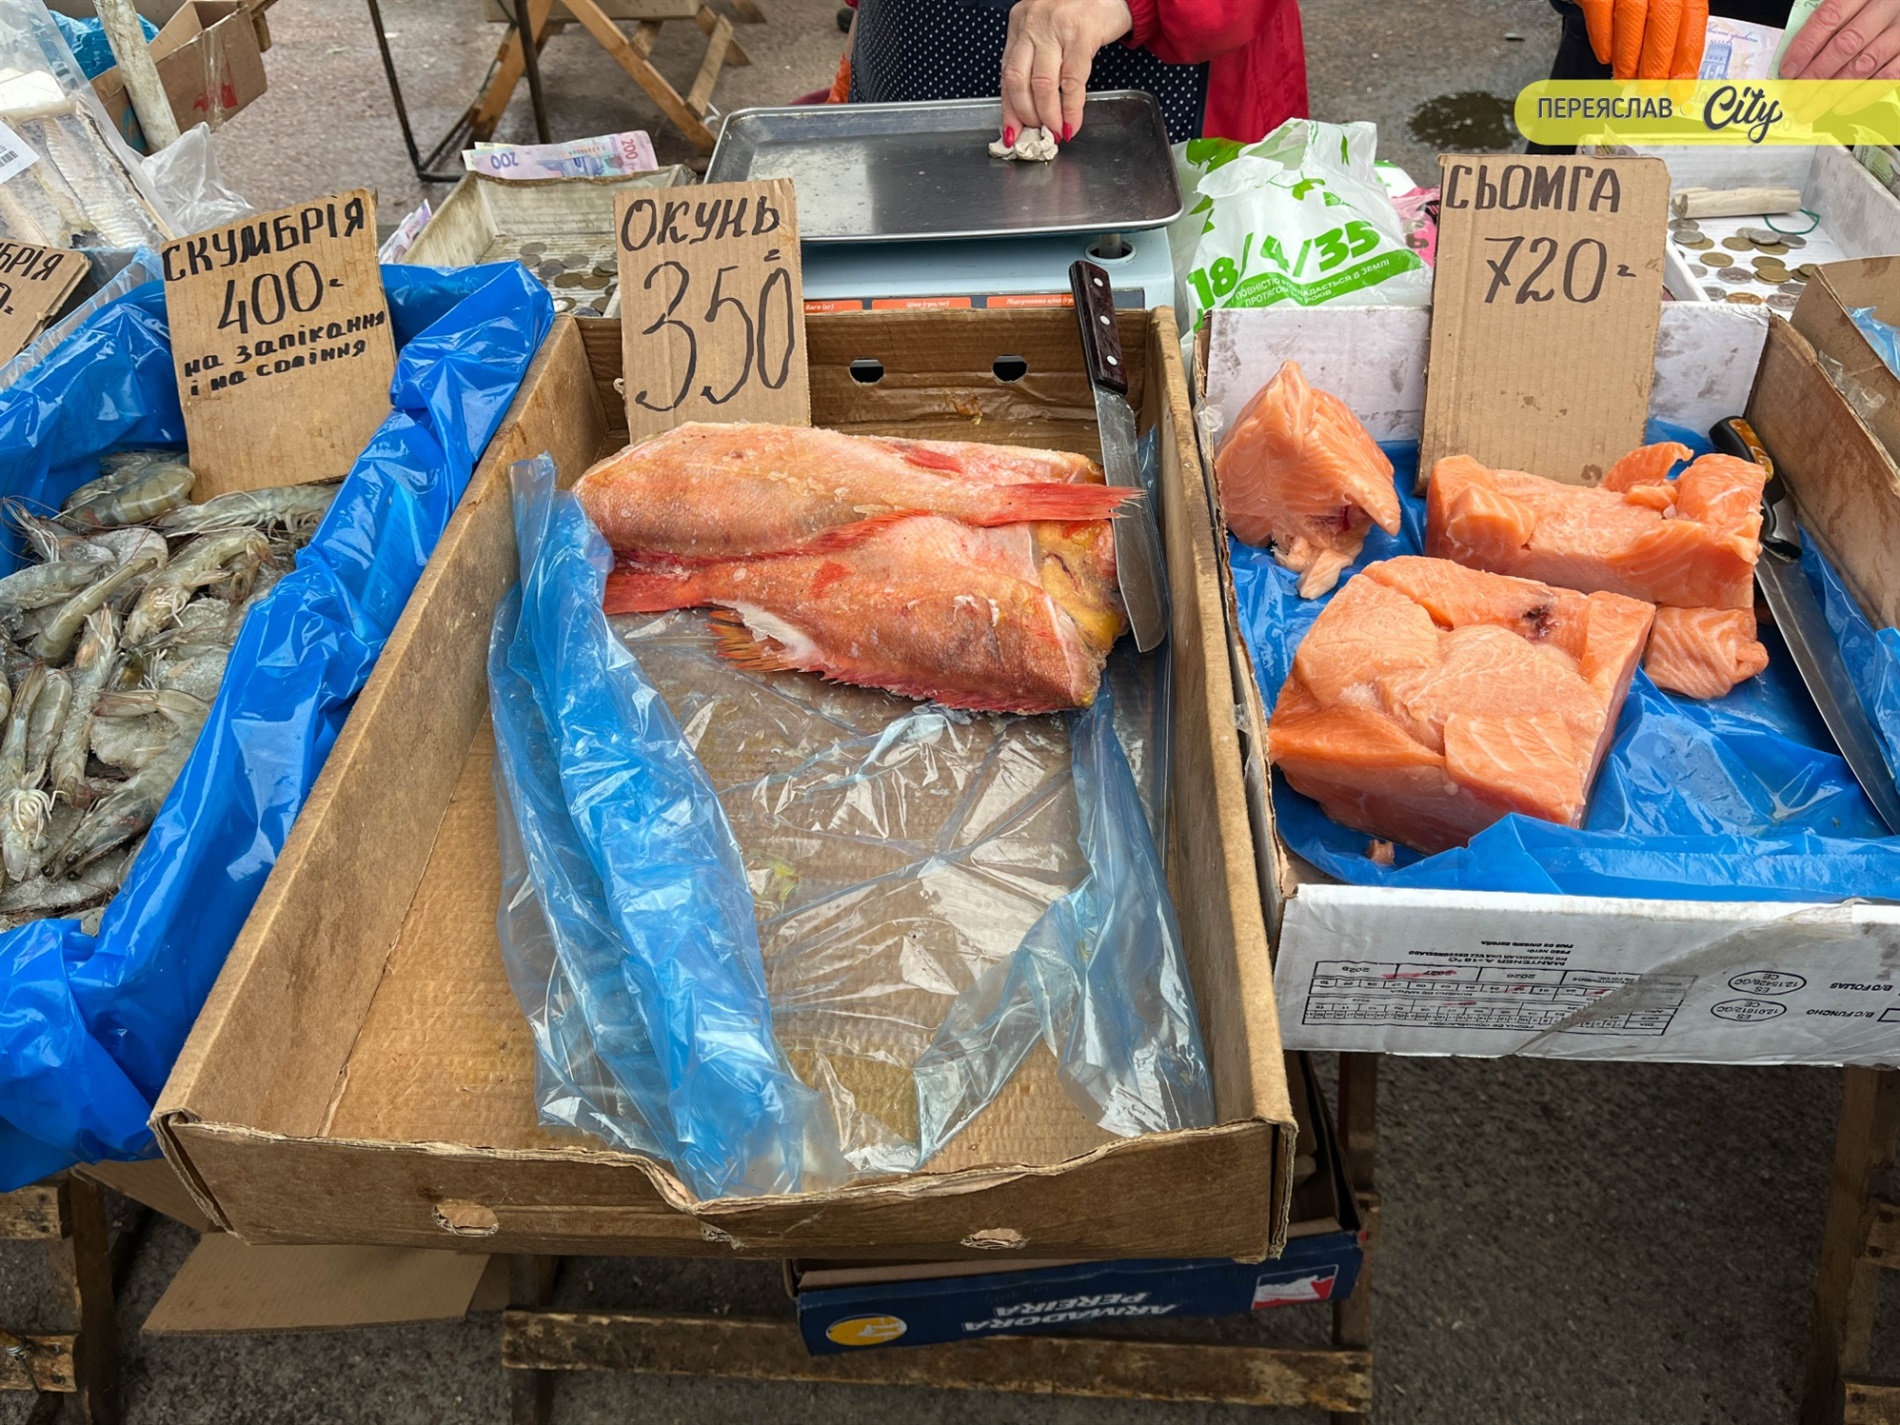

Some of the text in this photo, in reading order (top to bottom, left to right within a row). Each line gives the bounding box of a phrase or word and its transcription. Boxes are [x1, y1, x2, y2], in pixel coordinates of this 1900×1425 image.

[491, 151, 519, 169] 200
[621, 138, 638, 160] 200
[1446, 164, 1621, 213] СЬОМГА
[621, 195, 780, 252] ОКУНЬ
[162, 196, 365, 282] СКУМБРІЯ
[1235, 277, 1281, 300] ПОВНІСТЮ
[1361, 258, 1390, 275] ЗЕМЛІ
[1245, 286, 1289, 307] ПРОТЯГОМ
[1305, 289, 1332, 304] РОКІВ
[185, 311, 385, 377] на запікання
[190, 380, 199, 396] і
[210, 370, 247, 391] на
[1806, 1008, 1852, 1017] FUNCHO
[962, 1303, 1177, 1331] ARMADORA
[994, 1292, 1150, 1318] PEREIRA
